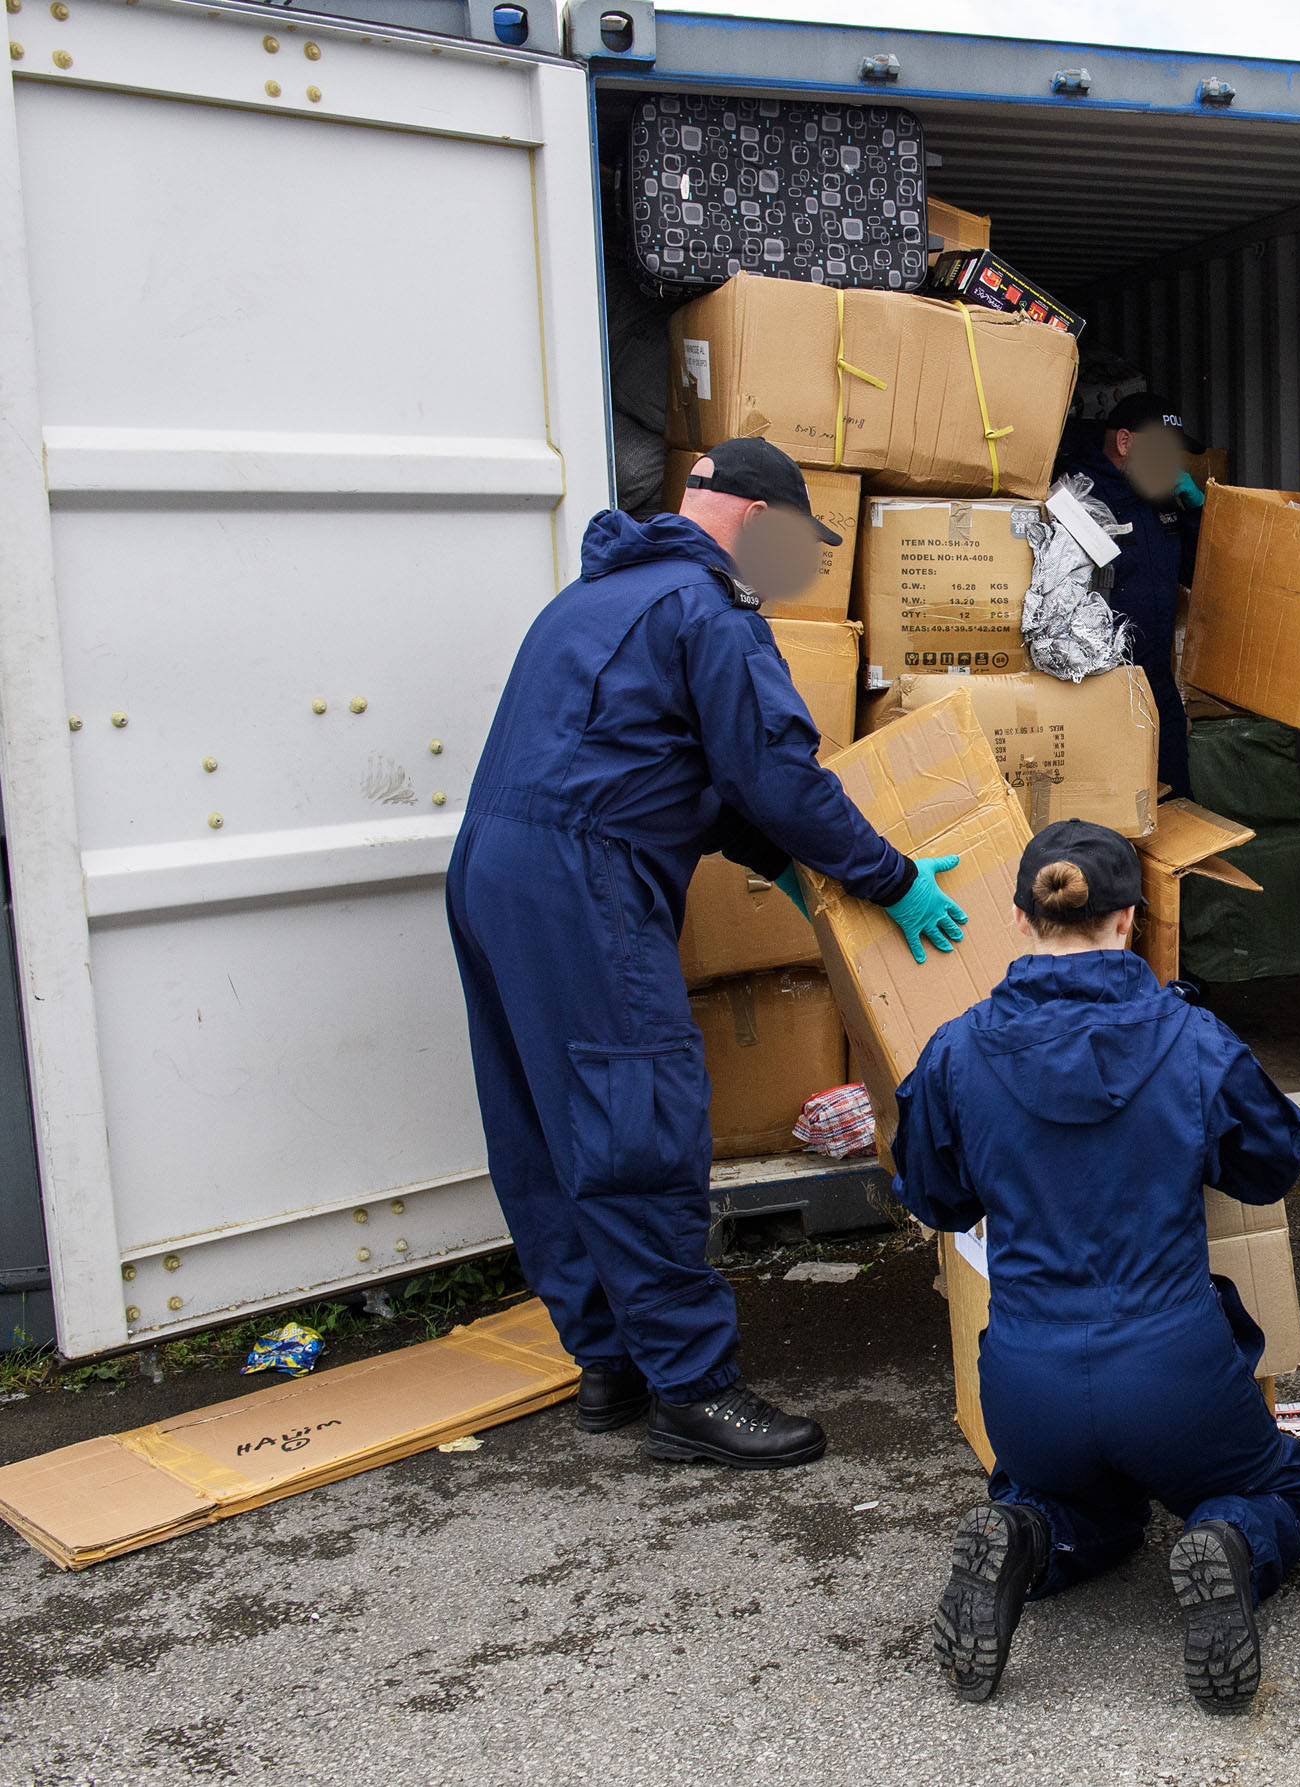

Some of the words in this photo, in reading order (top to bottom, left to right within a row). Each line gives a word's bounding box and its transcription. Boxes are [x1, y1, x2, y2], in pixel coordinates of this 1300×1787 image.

[828, 511, 856, 531] 220
[901, 539, 925, 547] ITEM
[956, 554, 994, 562] HA-4008
[901, 568, 937, 576] NOTES:
[901, 582, 926, 590] G.W.:
[740, 594, 759, 606] 13039
